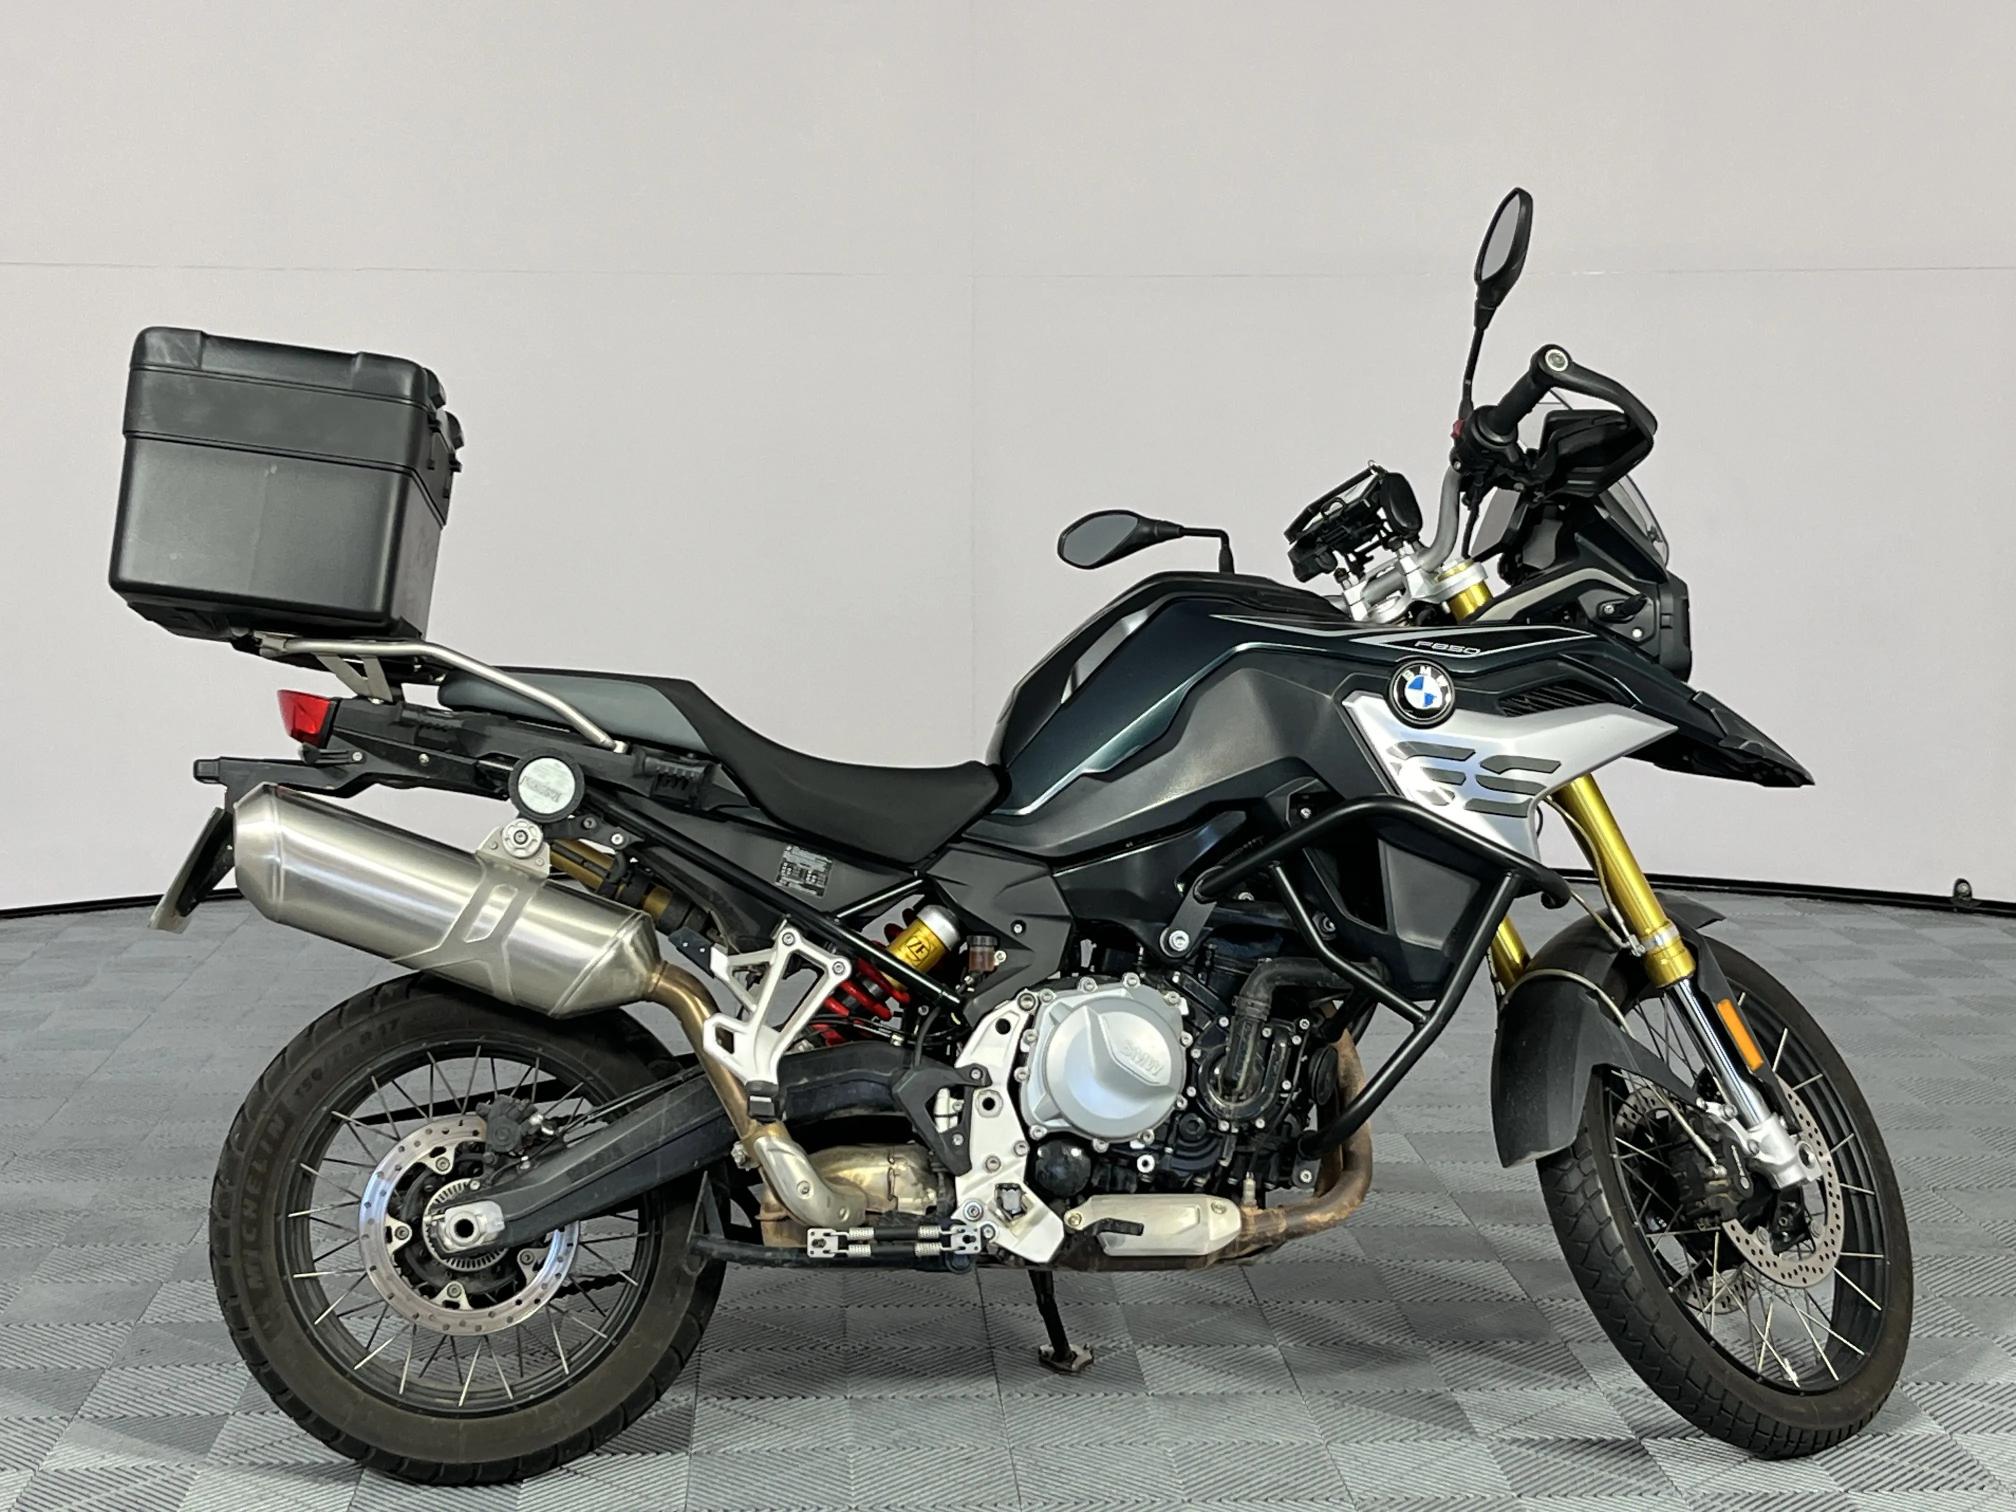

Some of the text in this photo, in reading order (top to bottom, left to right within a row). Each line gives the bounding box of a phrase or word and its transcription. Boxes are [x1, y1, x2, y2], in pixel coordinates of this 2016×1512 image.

[1414, 640, 1482, 655] F850
[1402, 665, 1449, 687] BMW
[1120, 1040, 1163, 1075] BMW
[241, 1112, 287, 1290] MICHELIN
